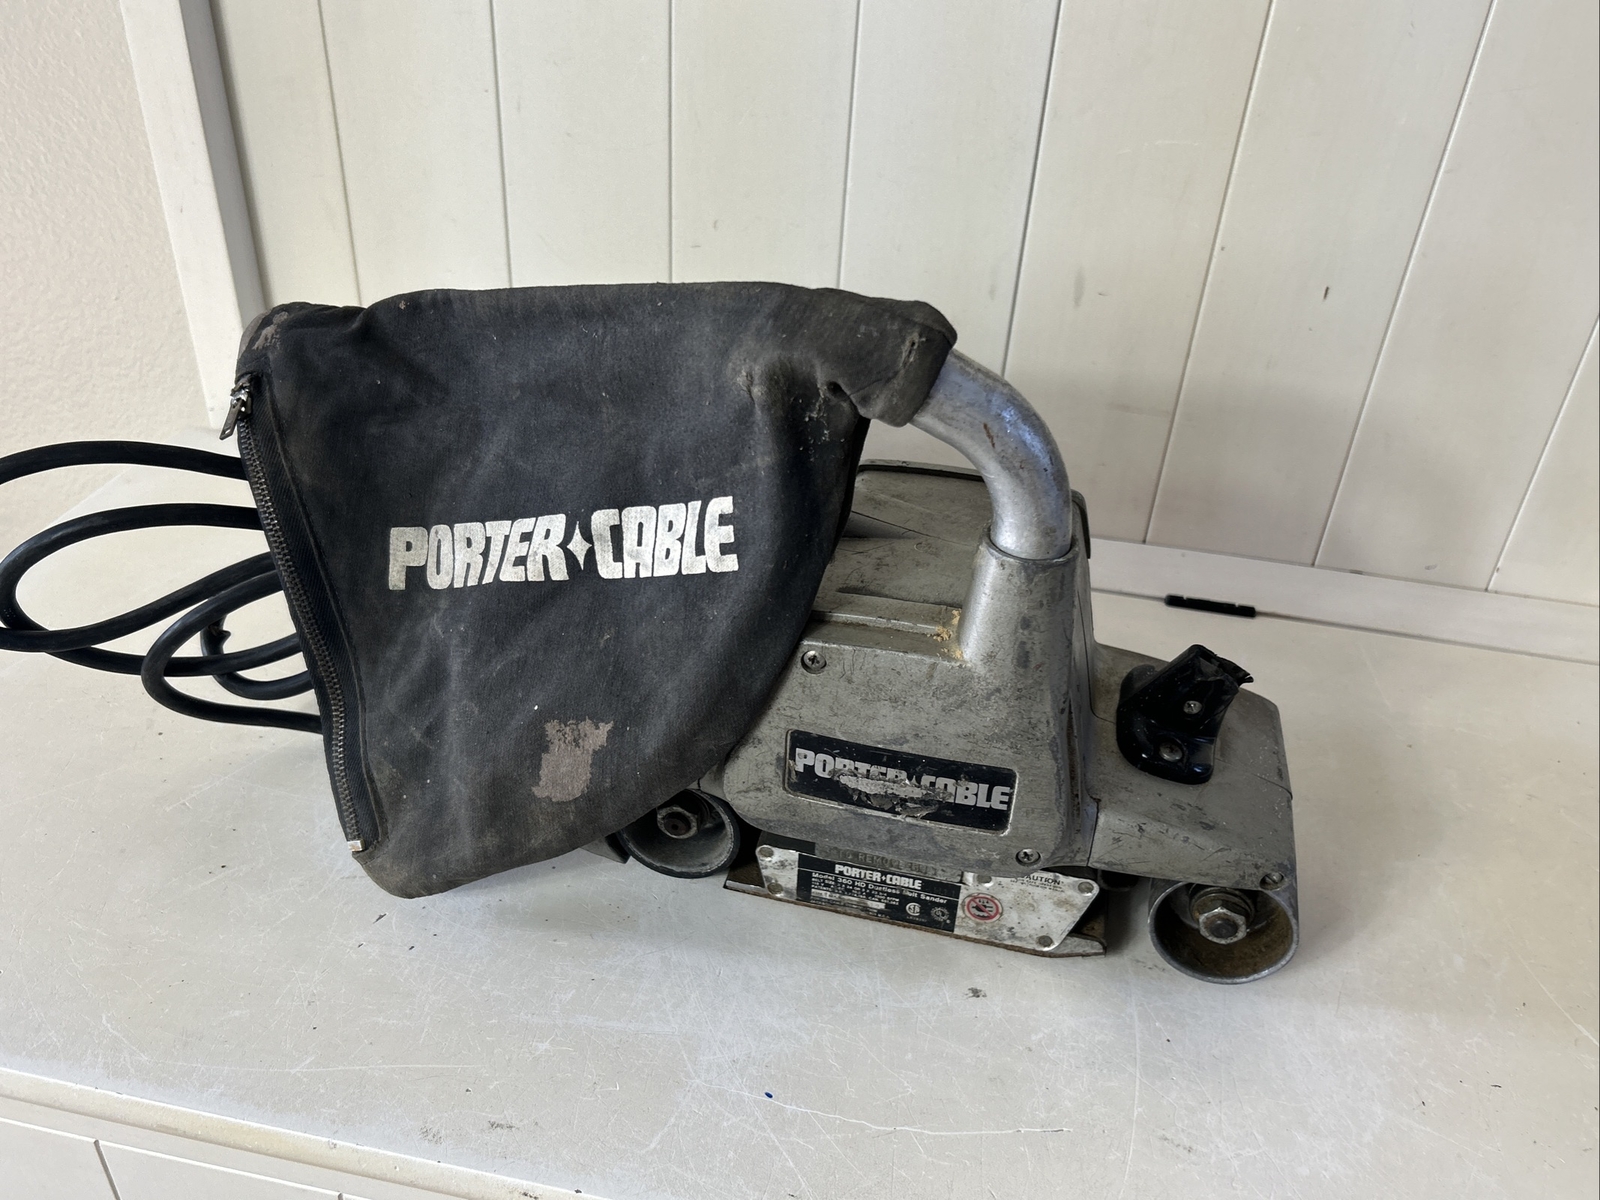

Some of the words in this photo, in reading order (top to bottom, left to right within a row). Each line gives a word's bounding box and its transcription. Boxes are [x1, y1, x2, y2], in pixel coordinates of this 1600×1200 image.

[388, 513, 569, 591] PORTER
[591, 496, 739, 579] CABLE
[812, 872, 835, 881] Model
[837, 877, 853, 885] 360
[920, 893, 948, 904] Sander
[835, 864, 882, 881] PORTER
[886, 875, 923, 889] CABLE
